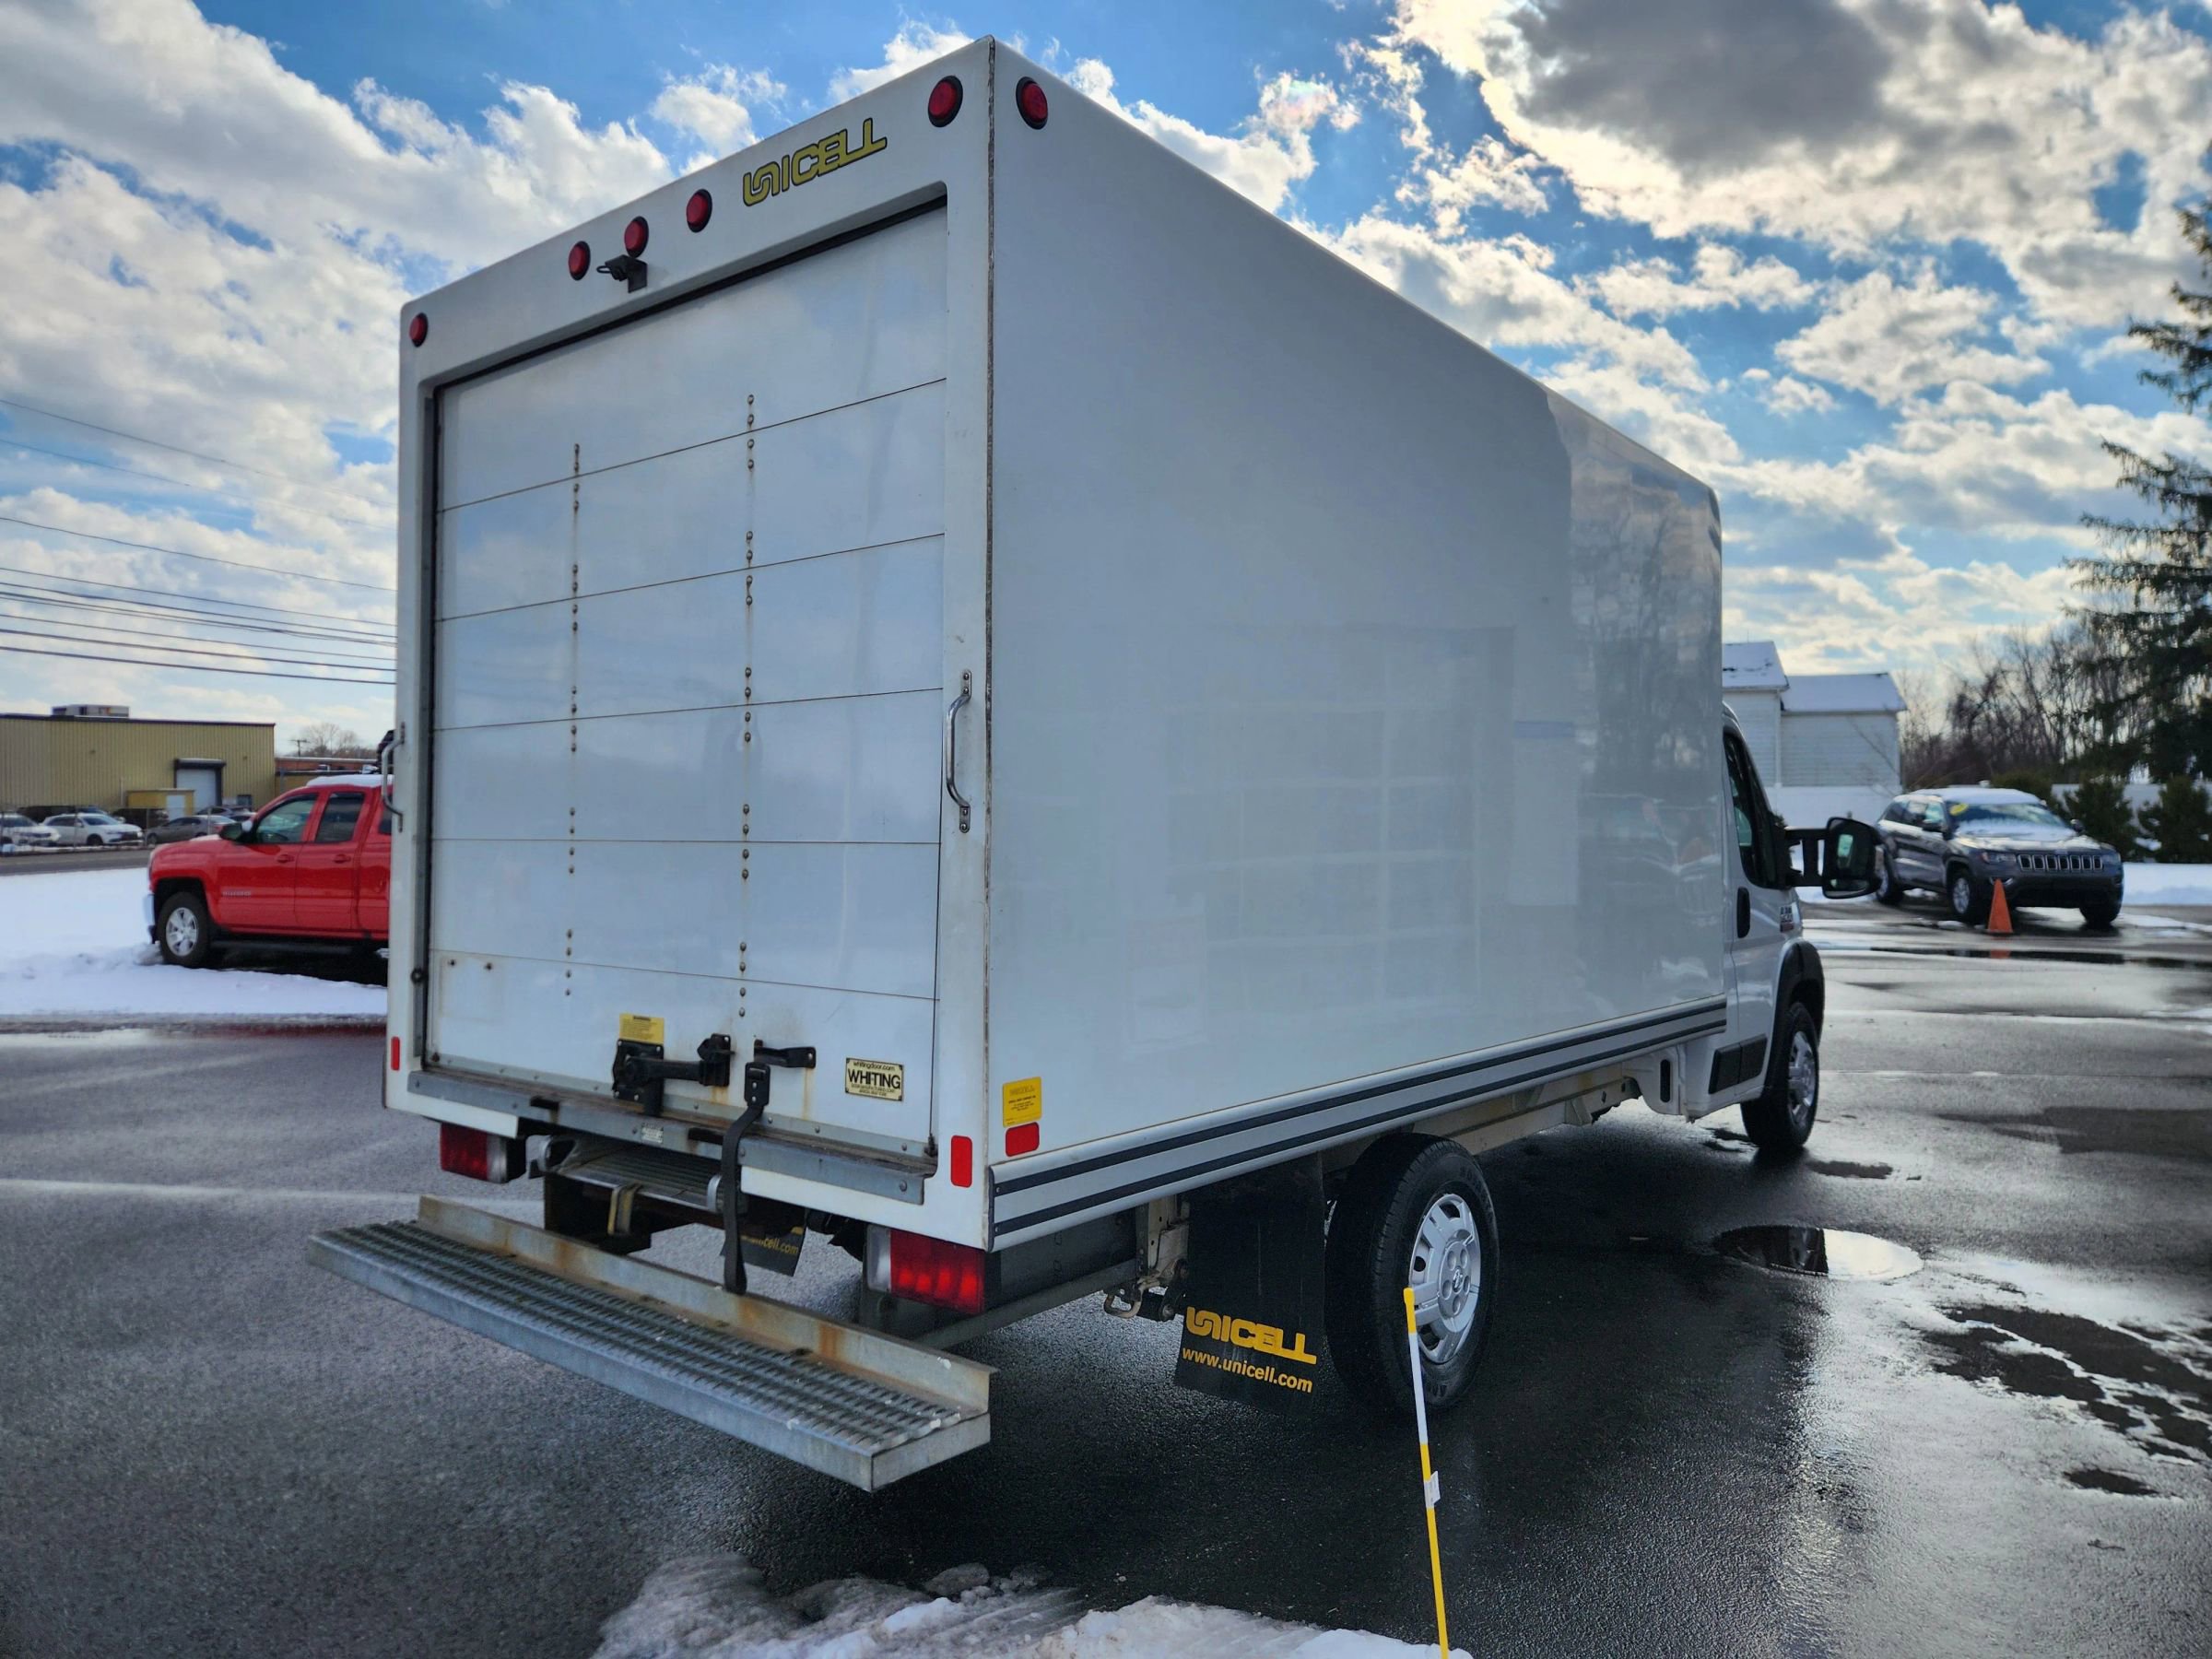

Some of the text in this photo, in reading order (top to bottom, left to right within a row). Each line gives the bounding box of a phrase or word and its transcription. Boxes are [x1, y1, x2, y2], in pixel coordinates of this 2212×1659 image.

[743, 117, 888, 206] UNICELL
[848, 1068, 901, 1089] WHITING
[1185, 1306, 1317, 1365] UNICELL
[1182, 1347, 1313, 1393] www.unicell.com
